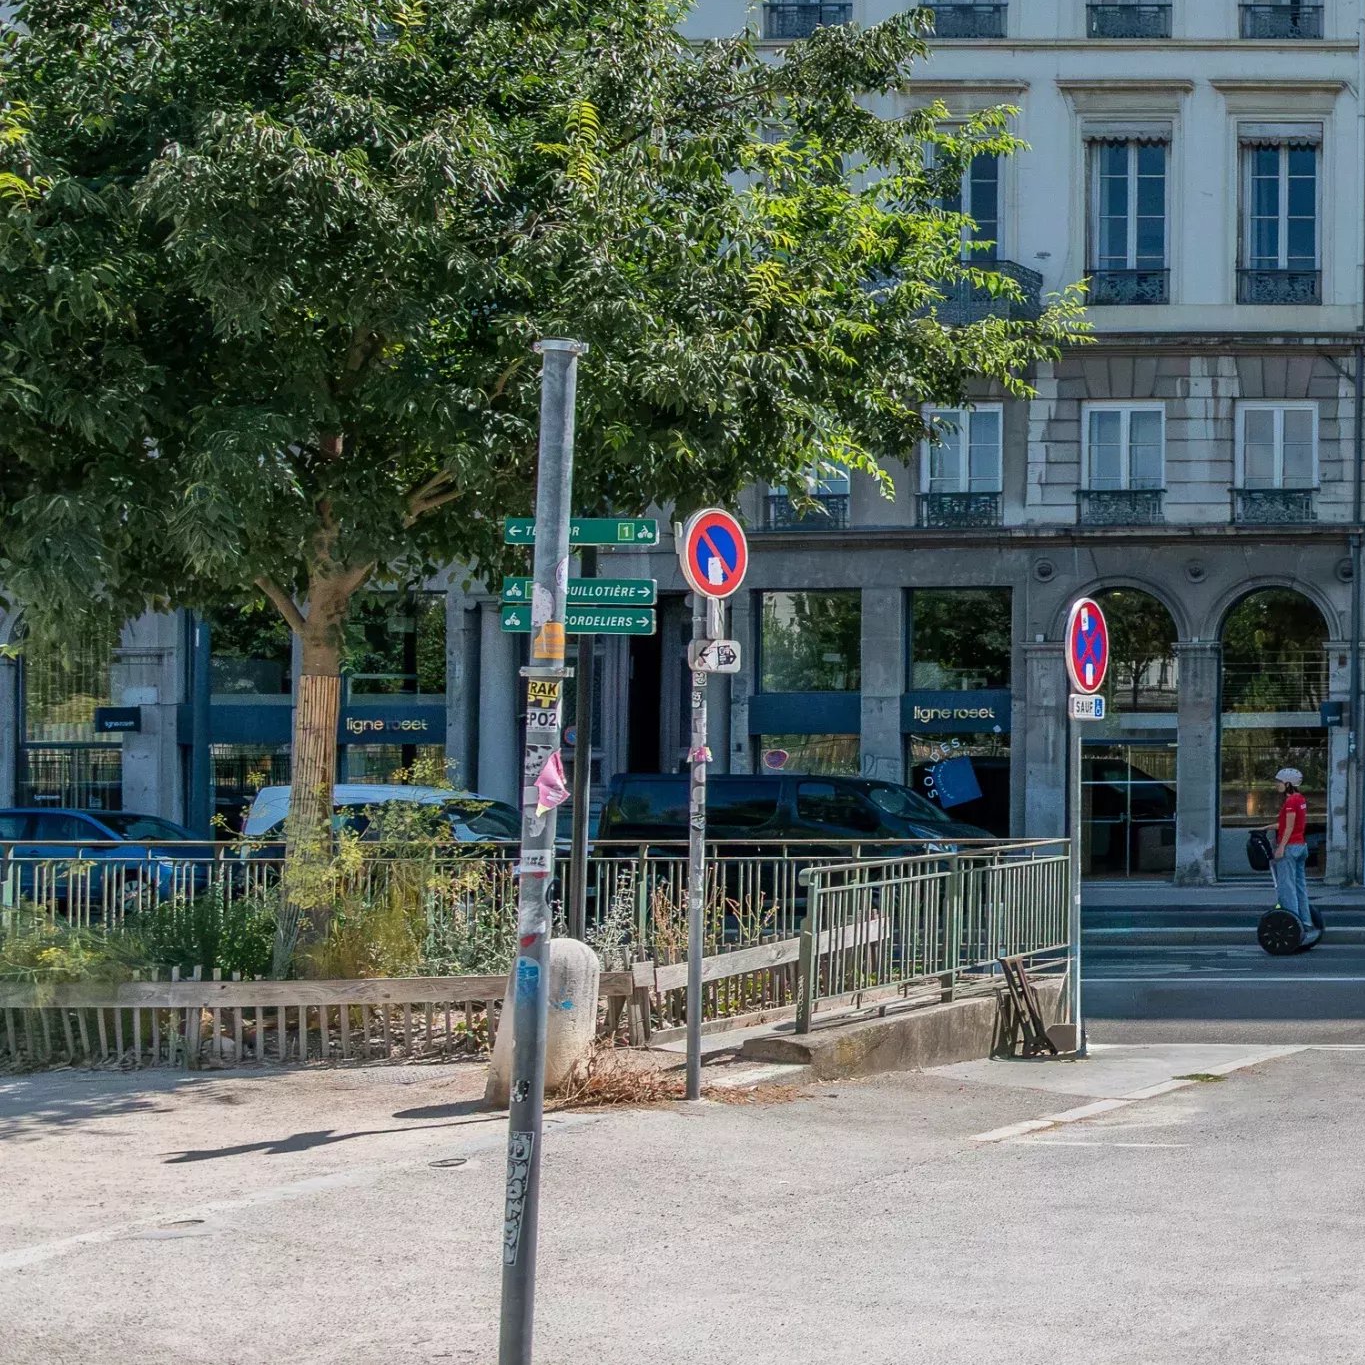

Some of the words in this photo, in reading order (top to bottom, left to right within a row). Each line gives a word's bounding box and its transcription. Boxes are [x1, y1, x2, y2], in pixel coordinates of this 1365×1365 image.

[622, 527, 629, 537] 1
[564, 616, 633, 626] CORDELIERS
[529, 682, 557, 695] RAK
[1076, 701, 1093, 713] SAUF
[914, 706, 951, 723] ligne
[954, 707, 995, 719] roset
[346, 717, 384, 734] ligne
[386, 718, 428, 730] roset
